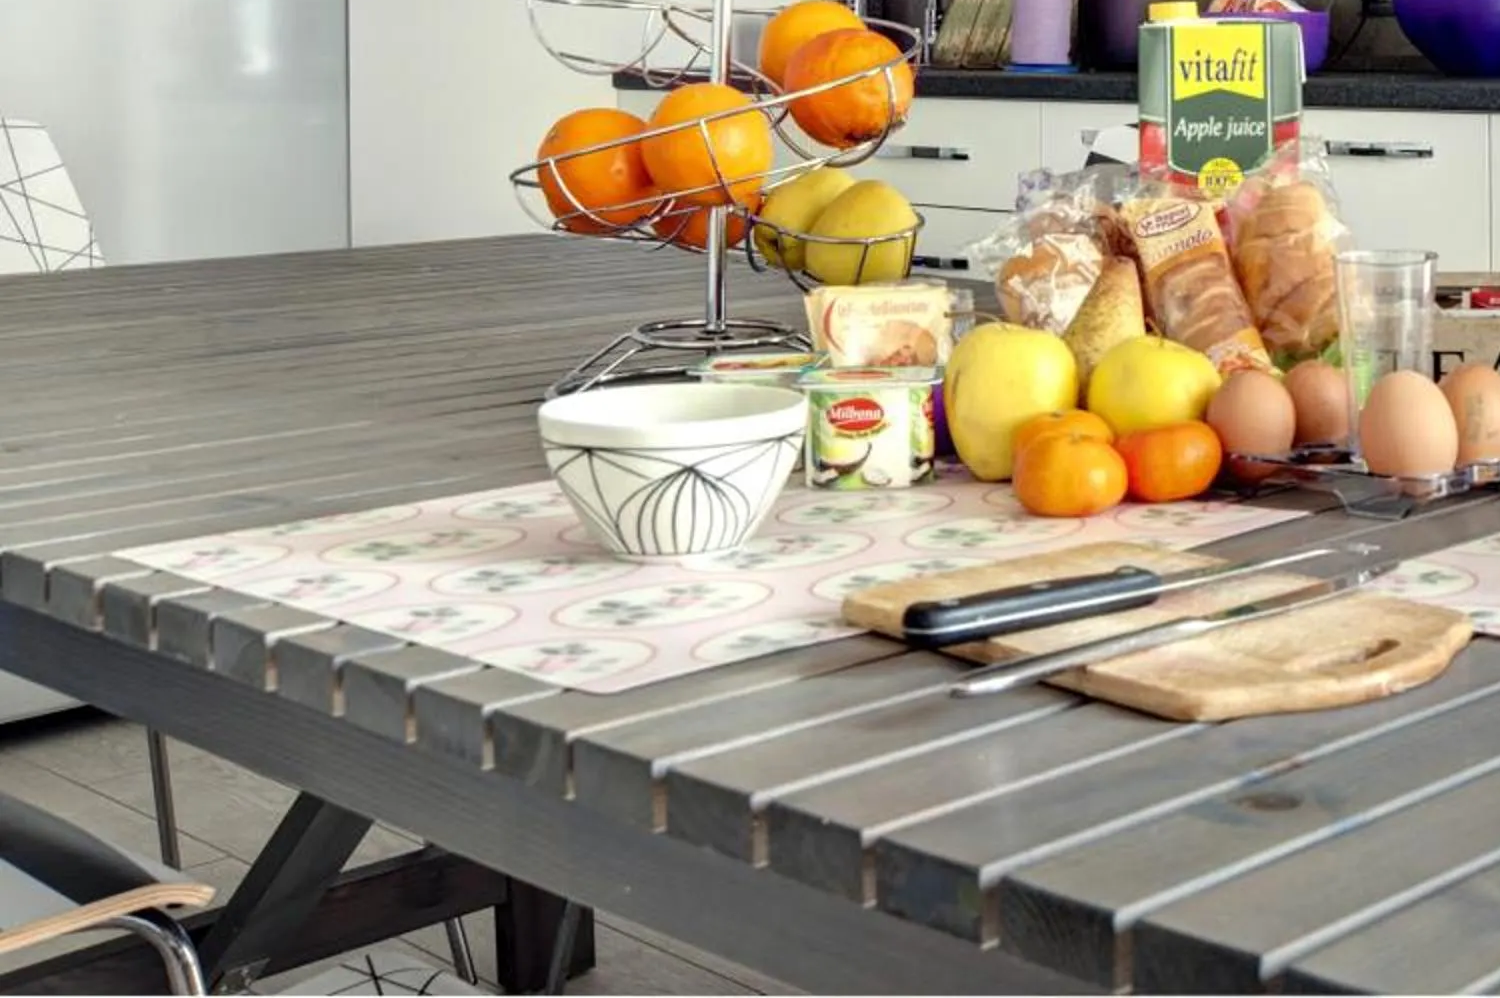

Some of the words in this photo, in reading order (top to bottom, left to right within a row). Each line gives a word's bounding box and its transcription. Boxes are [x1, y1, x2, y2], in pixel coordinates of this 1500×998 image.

[1179, 48, 1258, 82] vitafit
[1174, 115, 1222, 142] Apple
[1226, 116, 1265, 141] juice
